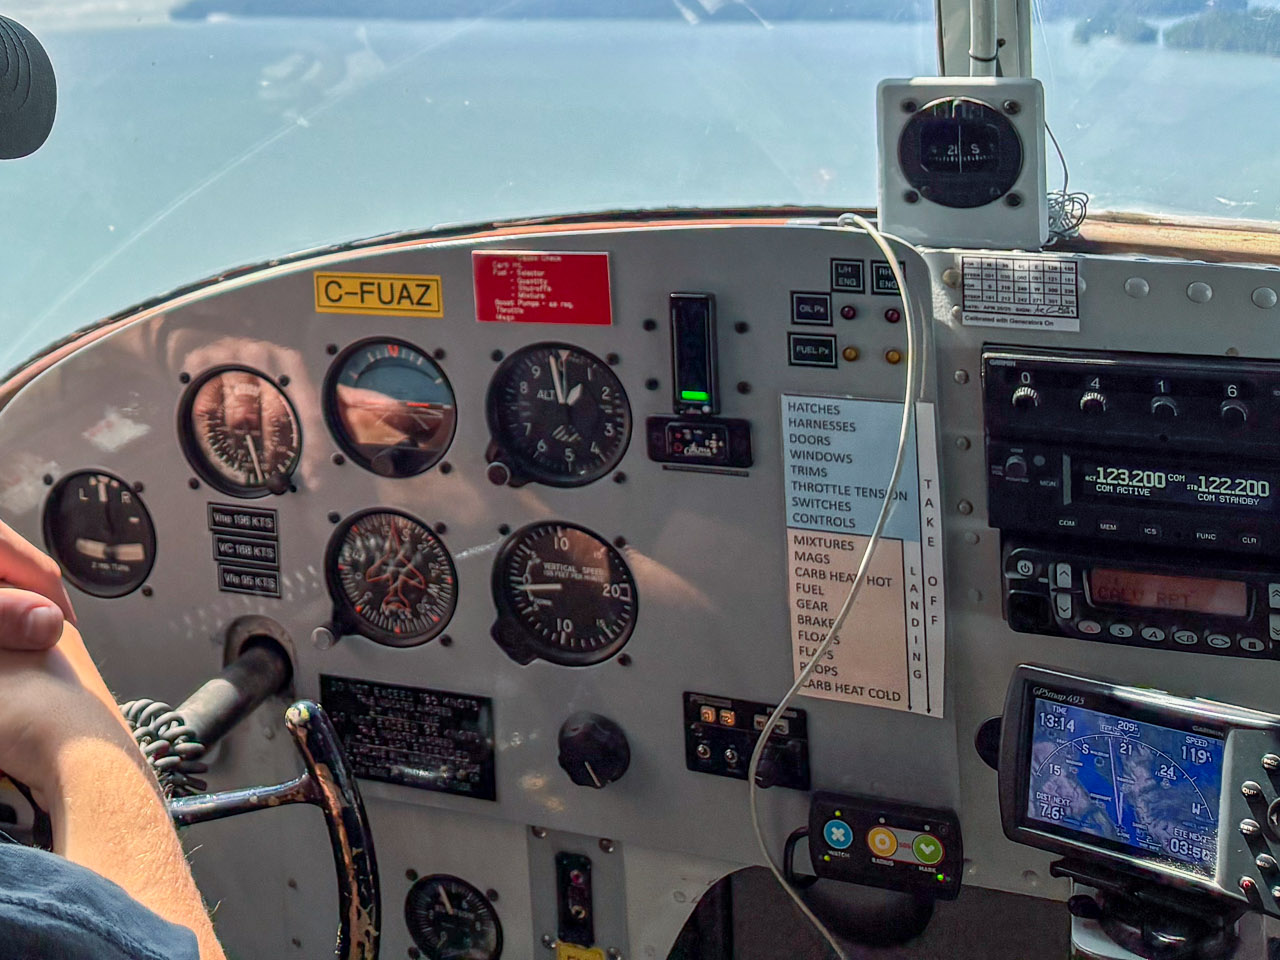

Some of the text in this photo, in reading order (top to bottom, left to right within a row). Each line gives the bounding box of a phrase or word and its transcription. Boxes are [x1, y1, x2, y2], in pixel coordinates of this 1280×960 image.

[971, 144, 979, 154] S
[839, 278, 856, 286] ENG
[325, 280, 432, 306] C-FUAZ
[800, 304, 813, 312] OIL
[964, 315, 995, 323] Calibrated
[1009, 318, 1043, 326] Generators
[796, 345, 817, 354] FUEL
[532, 365, 540, 378] 9
[520, 381, 528, 394] 8
[1090, 377, 1100, 389] 4
[537, 390, 555, 400] ALT
[602, 386, 611, 400] 2
[1227, 384, 1238, 398] 6
[788, 402, 840, 415] HATCHES
[524, 422, 531, 436] 7
[604, 423, 614, 436] 3
[789, 418, 856, 432] HARNESSES
[789, 433, 831, 446] DOORS
[565, 448, 574, 461] 5
[790, 449, 853, 464] WINDOWS
[791, 465, 827, 477] TRIMS
[792, 481, 851, 496] THROTTLE
[1097, 467, 1270, 497] 123.200 COM 122.200
[79, 488, 88, 500] L
[121, 491, 131, 503] R
[1096, 485, 1259, 506] COM ACTIVE COM STANDBY
[792, 497, 851, 511] SWITCHES
[252, 515, 273, 527] KTS
[793, 513, 856, 528] CONTROLS
[554, 536, 568, 550] 10
[794, 535, 854, 551] MIXTURES
[253, 547, 274, 558] KTS
[794, 551, 830, 564] MAGS
[924, 479, 939, 625] TAKE OFF
[255, 577, 275, 587] KTS
[795, 567, 892, 588] CARB HOT
[602, 584, 620, 597] 20
[796, 583, 824, 595] FUEL
[796, 599, 828, 612] GEAR
[557, 618, 572, 632] 10
[910, 566, 922, 680] LANDING
[798, 630, 840, 645] FLOAS
[835, 684, 900, 702] HEAT COLD
[1040, 713, 1075, 732] 13:14
[1186, 736, 1208, 747] SPEED
[1081, 744, 1090, 754] S
[1120, 743, 1132, 755] 21
[1049, 764, 1061, 775] 15
[1160, 765, 1174, 777] 24
[1192, 803, 1200, 814] W
